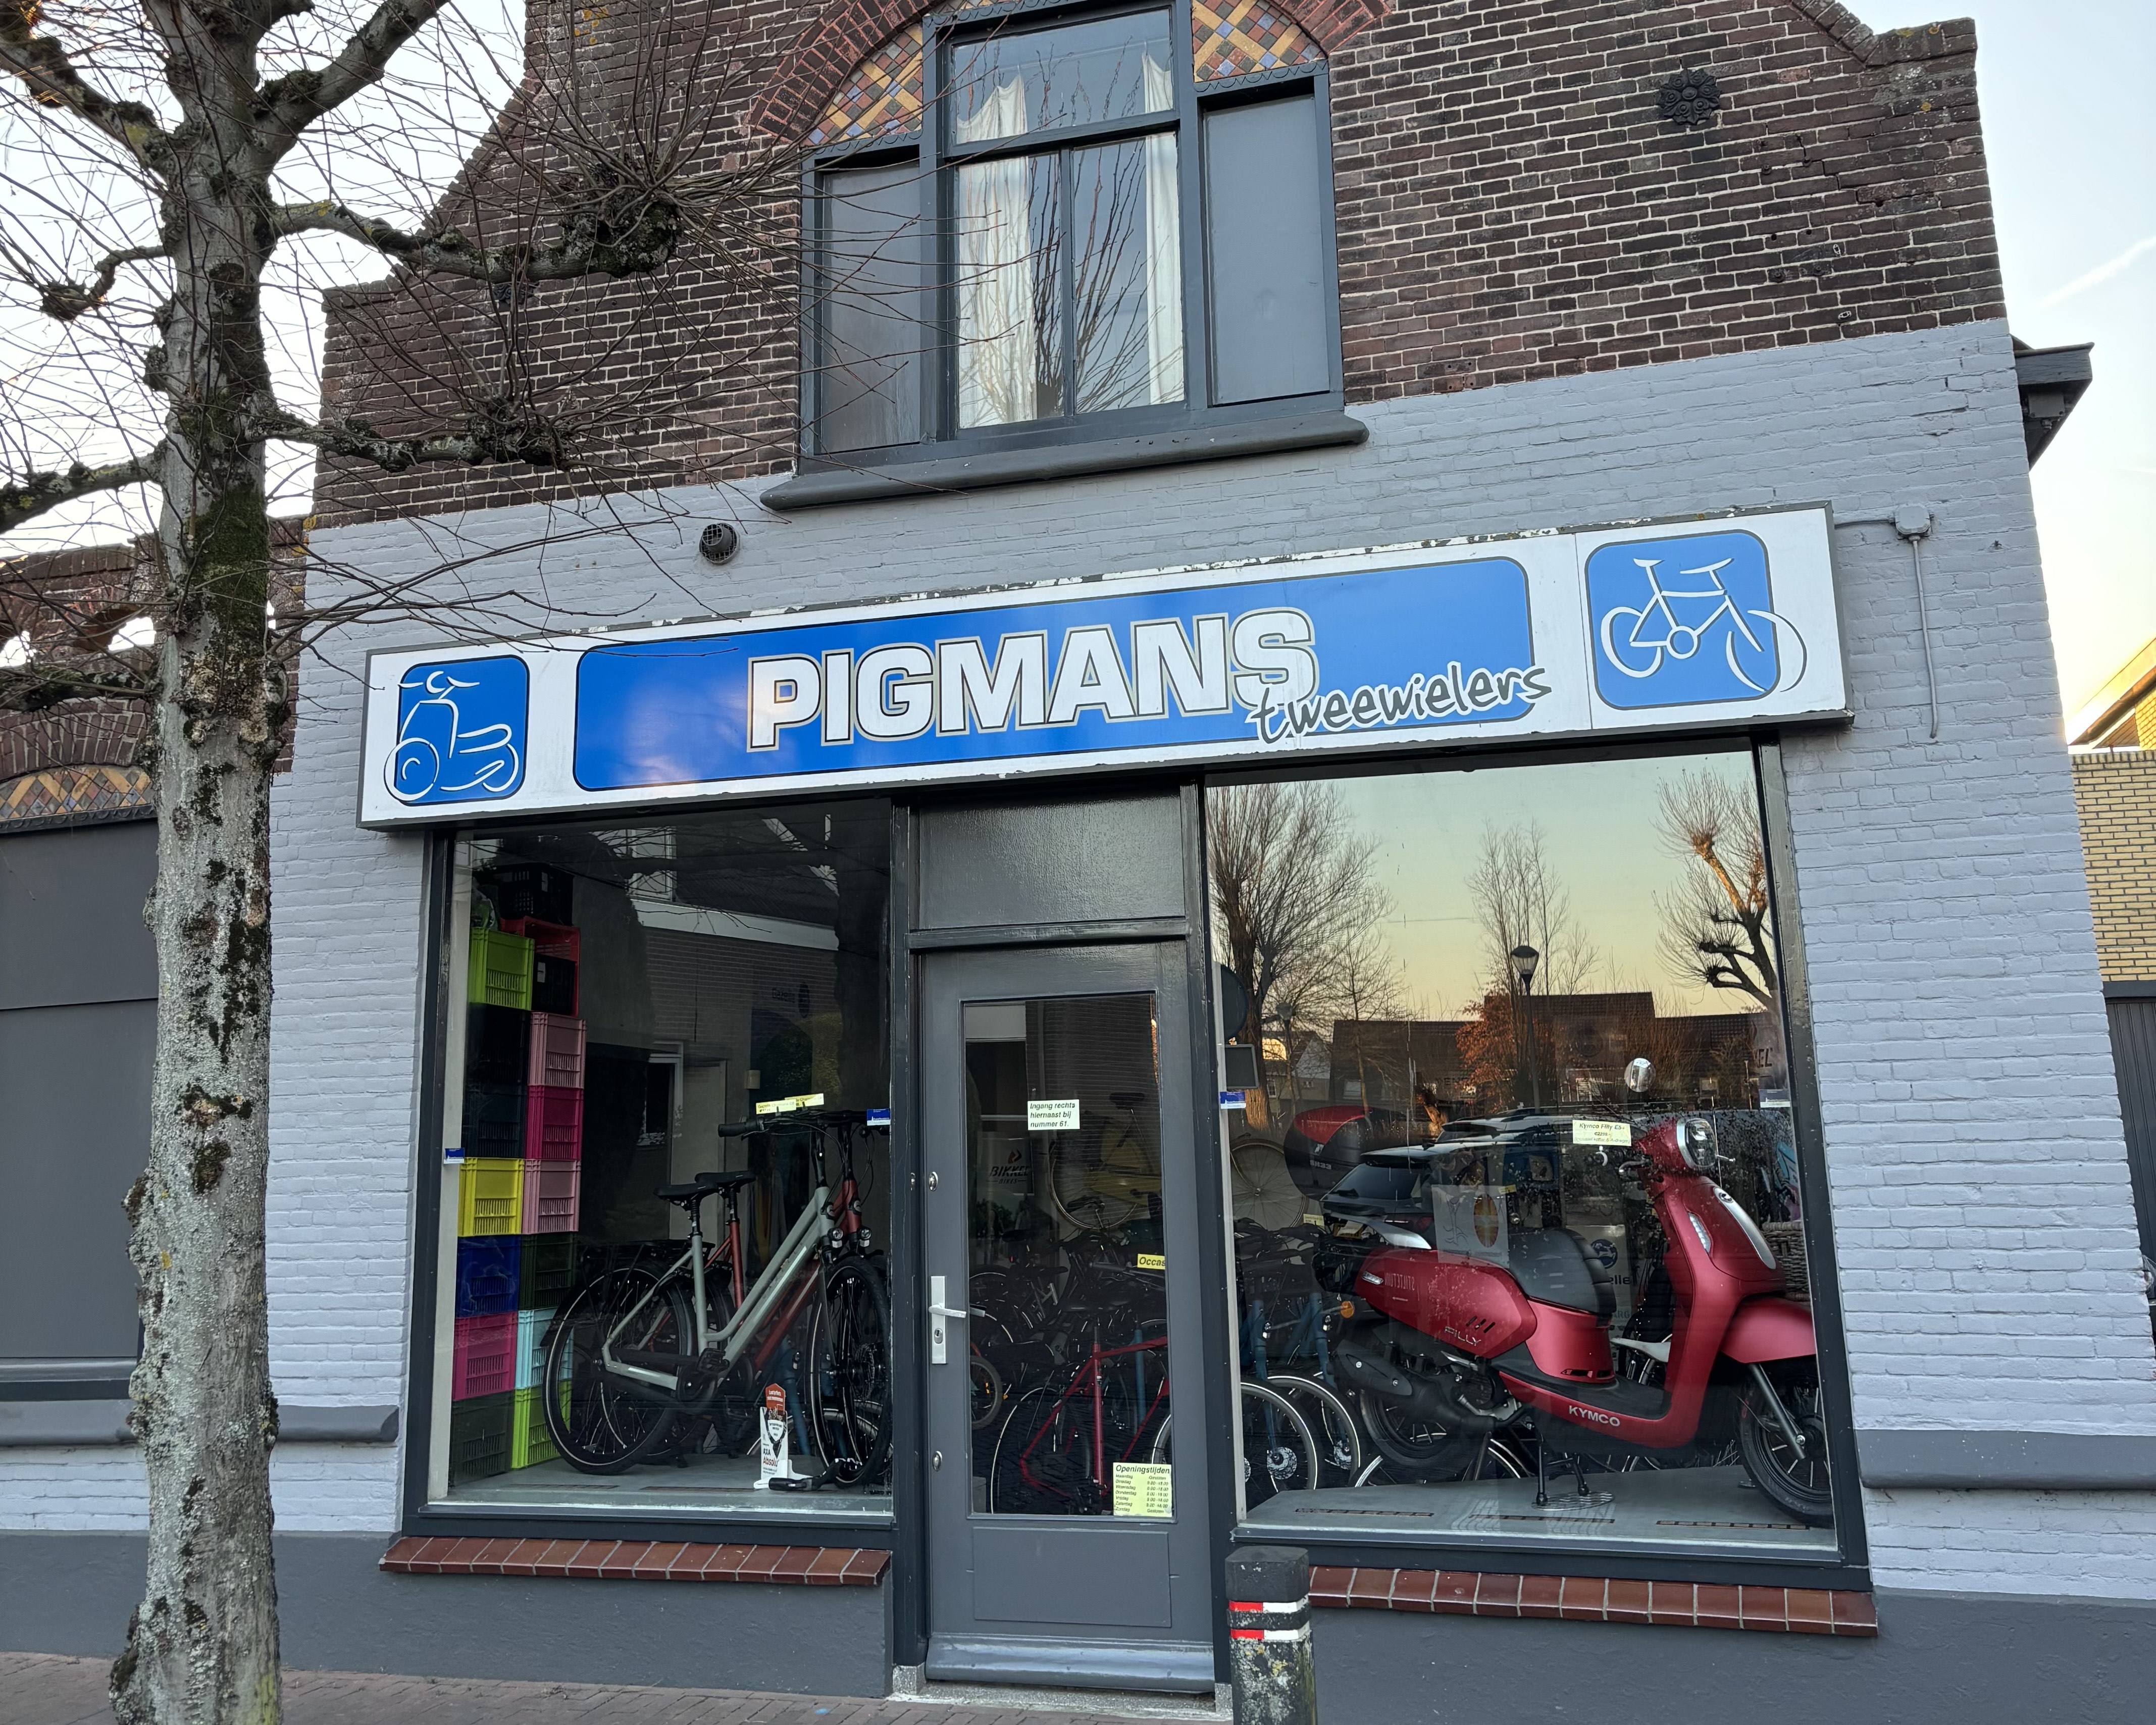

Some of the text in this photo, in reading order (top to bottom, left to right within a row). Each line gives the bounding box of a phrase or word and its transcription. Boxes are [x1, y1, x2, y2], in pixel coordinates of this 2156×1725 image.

[749, 608, 1317, 751] PIGMANS
[1249, 664, 1552, 744] tweewielers
[1063, 1111, 1071, 1119] bij
[1139, 1256, 1166, 1266] Occas
[1569, 1405, 1620, 1427] KYMCO
[1115, 1464, 1170, 1475] Openingstijden
